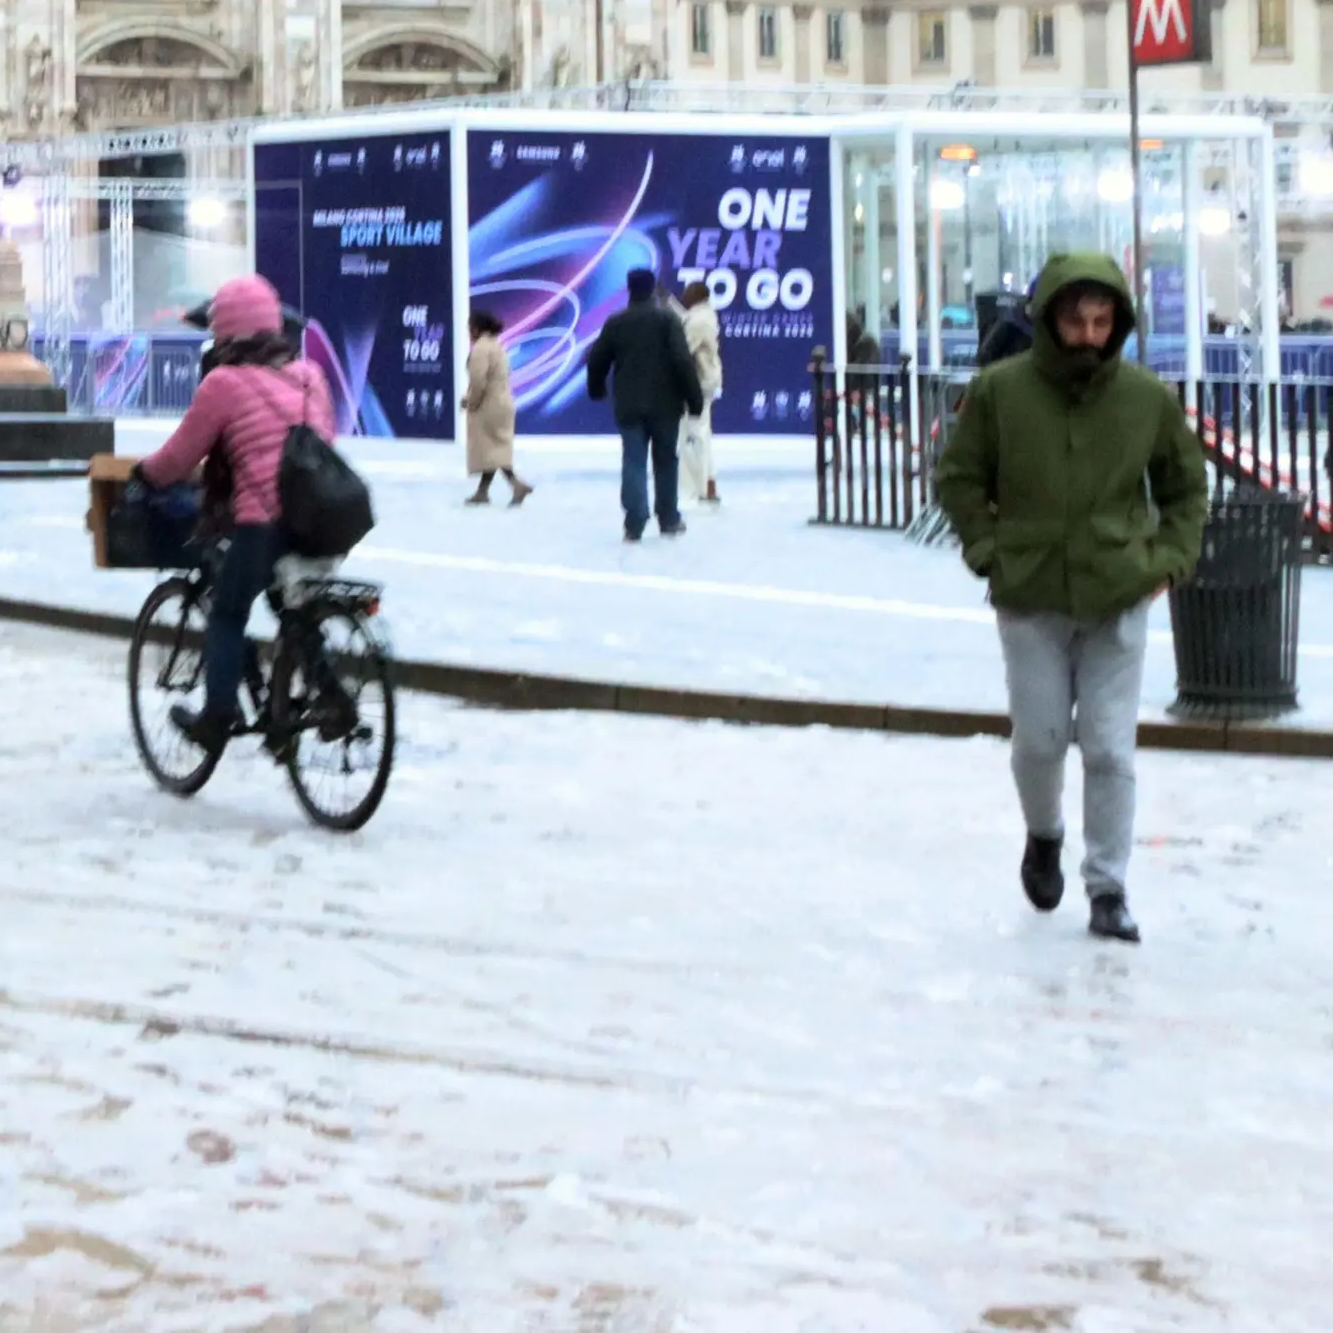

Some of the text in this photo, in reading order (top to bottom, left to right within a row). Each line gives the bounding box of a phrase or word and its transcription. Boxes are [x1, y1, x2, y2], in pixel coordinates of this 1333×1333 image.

[718, 187, 811, 231] ONE
[340, 220, 443, 247] SPORT VILLAGE
[667, 227, 782, 269] YEAR
[677, 267, 813, 310] TO GO
[402, 305, 428, 327] ONE
[403, 338, 440, 361] TO GO
